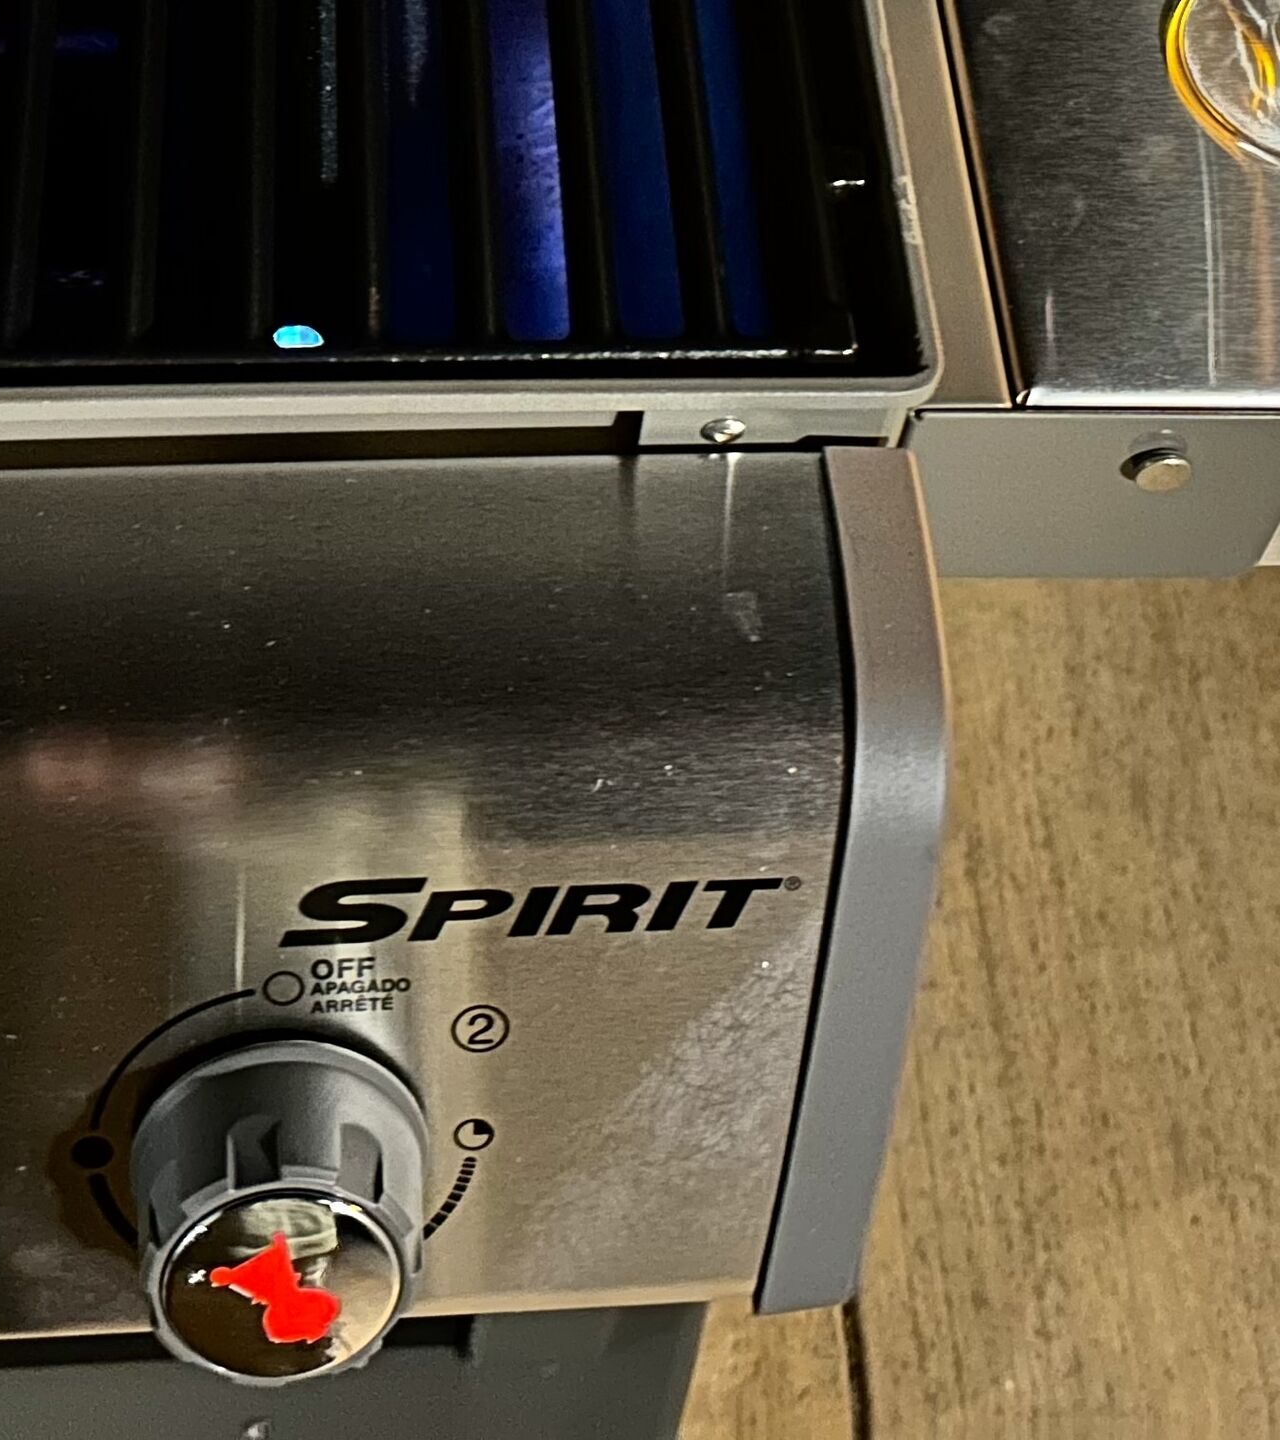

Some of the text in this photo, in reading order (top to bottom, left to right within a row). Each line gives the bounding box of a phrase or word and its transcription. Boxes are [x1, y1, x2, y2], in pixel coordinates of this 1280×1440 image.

[279, 877, 785, 948] SPIRIT
[310, 957, 376, 980] OFF
[310, 978, 411, 996] APAGADO
[310, 993, 394, 1015] ARRÊTÉ
[467, 1013, 494, 1045] 2
